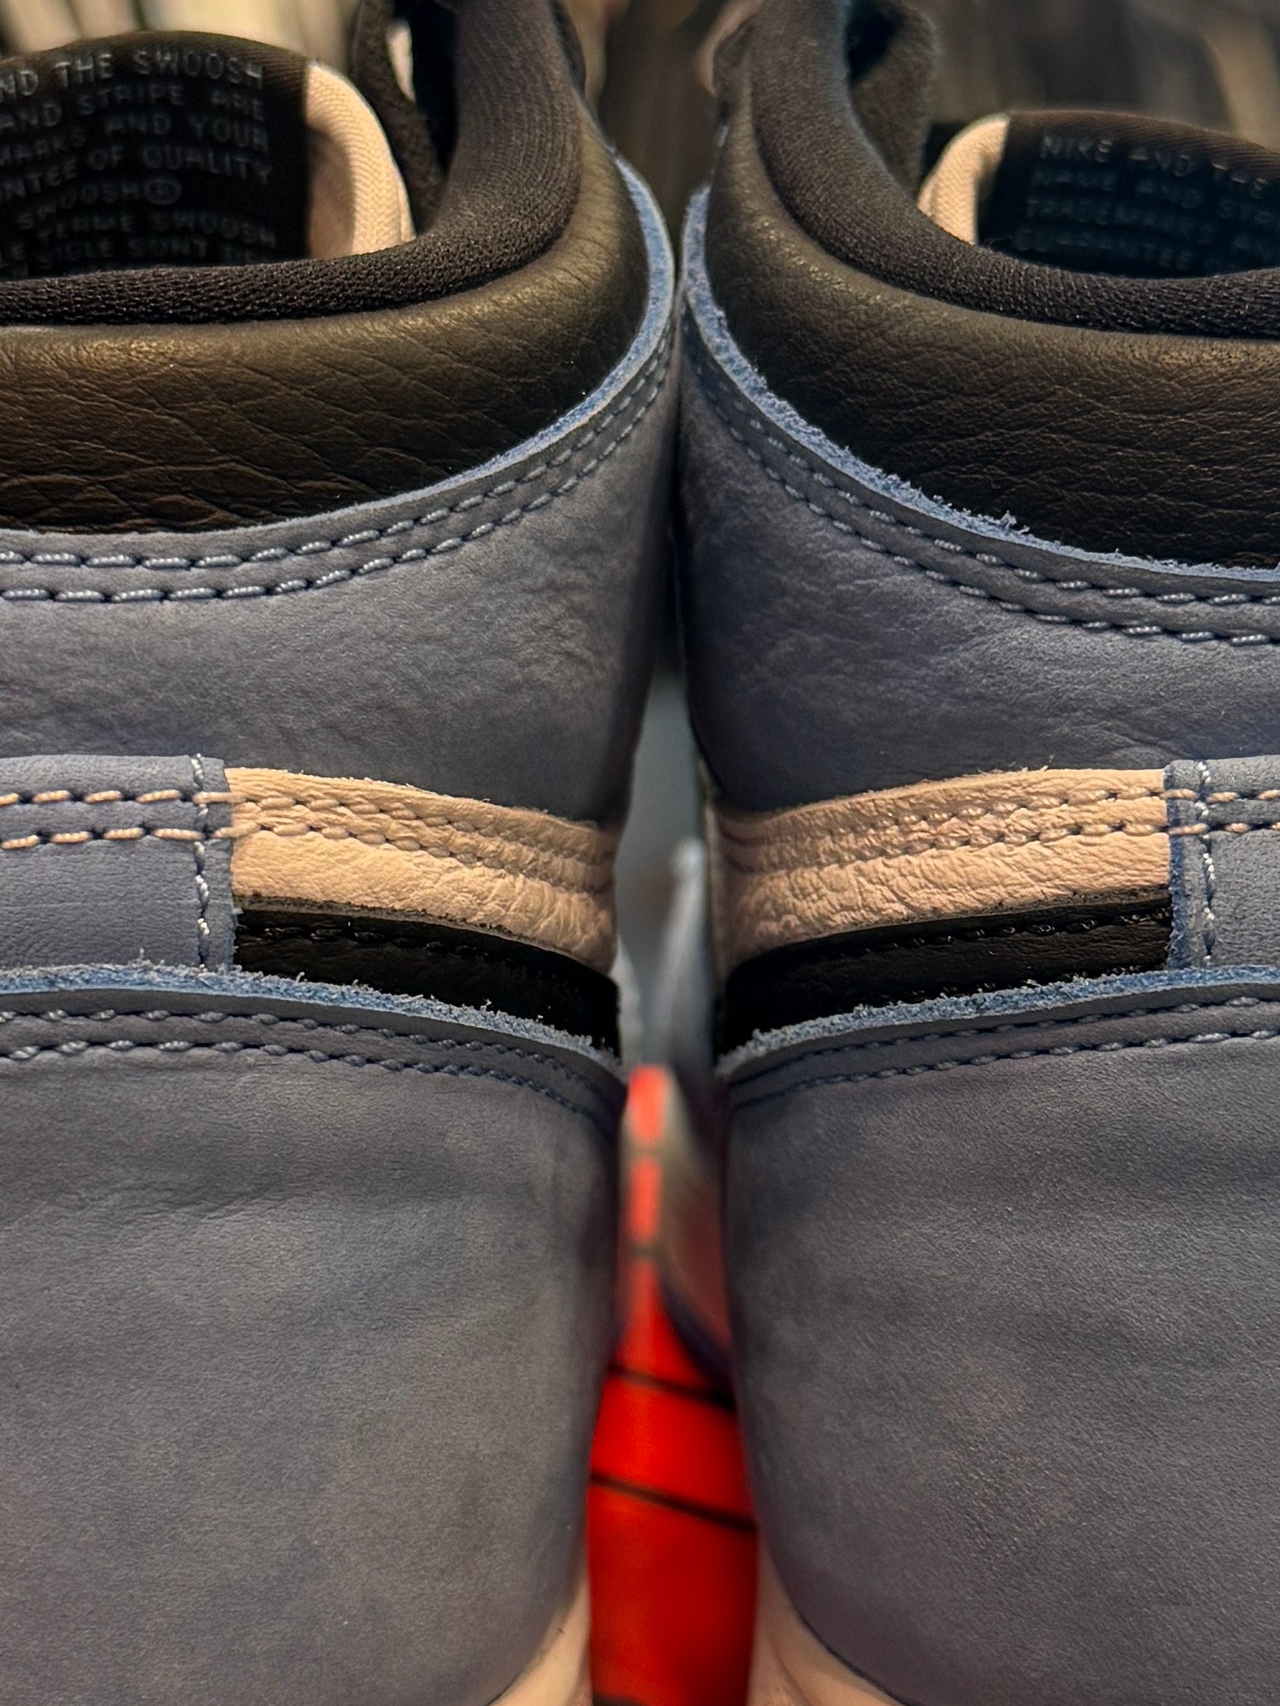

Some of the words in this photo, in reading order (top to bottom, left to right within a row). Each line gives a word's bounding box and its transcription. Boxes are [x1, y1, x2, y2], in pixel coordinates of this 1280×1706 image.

[54, 53, 114, 88] THE
[134, 50, 263, 90] SWOOSH
[79, 83, 185, 116] STRIPE
[211, 90, 264, 122] ARE
[104, 113, 171, 136] AND
[188, 115, 268, 154] YOUR
[1039, 135, 1113, 163] NIKE
[87, 145, 124, 171] OF
[142, 145, 272, 185] QUALITY
[152, 212, 276, 249] SWOOSH
